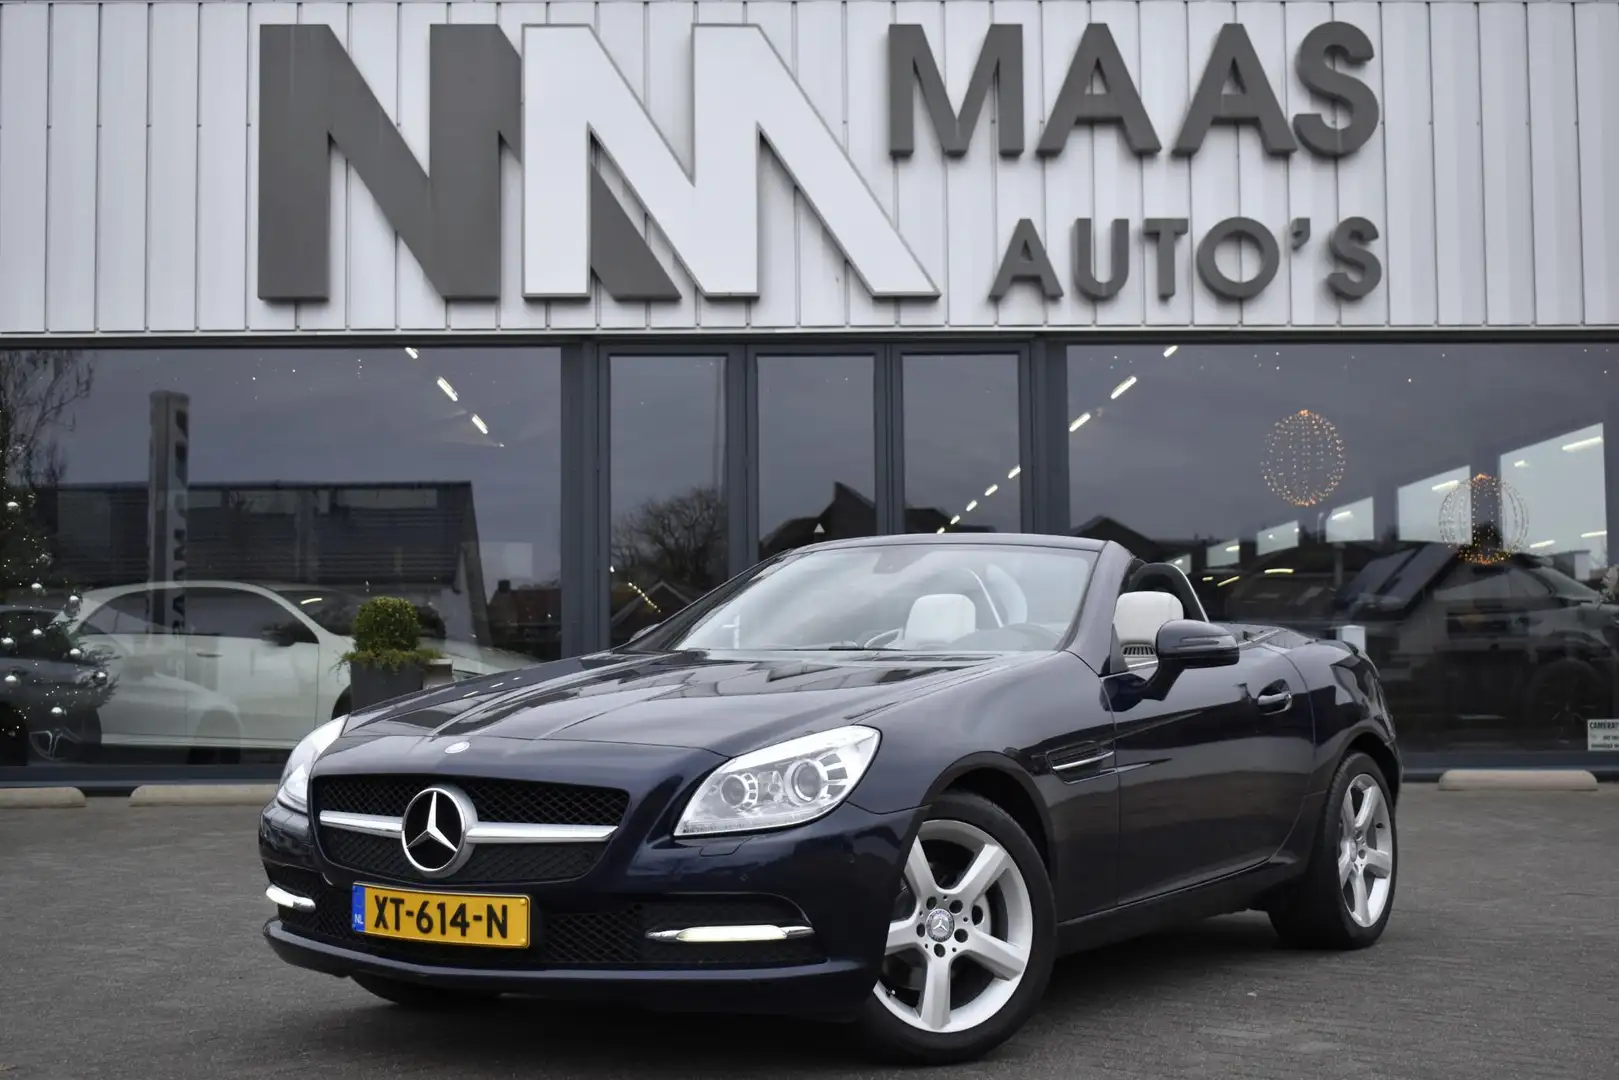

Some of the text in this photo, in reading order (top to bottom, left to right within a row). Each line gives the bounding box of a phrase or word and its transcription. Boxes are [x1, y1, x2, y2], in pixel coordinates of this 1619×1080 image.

[888, 21, 1380, 159] MAAS
[988, 216, 1382, 300] AUTO'S
[354, 913, 364, 925] NL
[374, 895, 508, 939] XT-614-N
